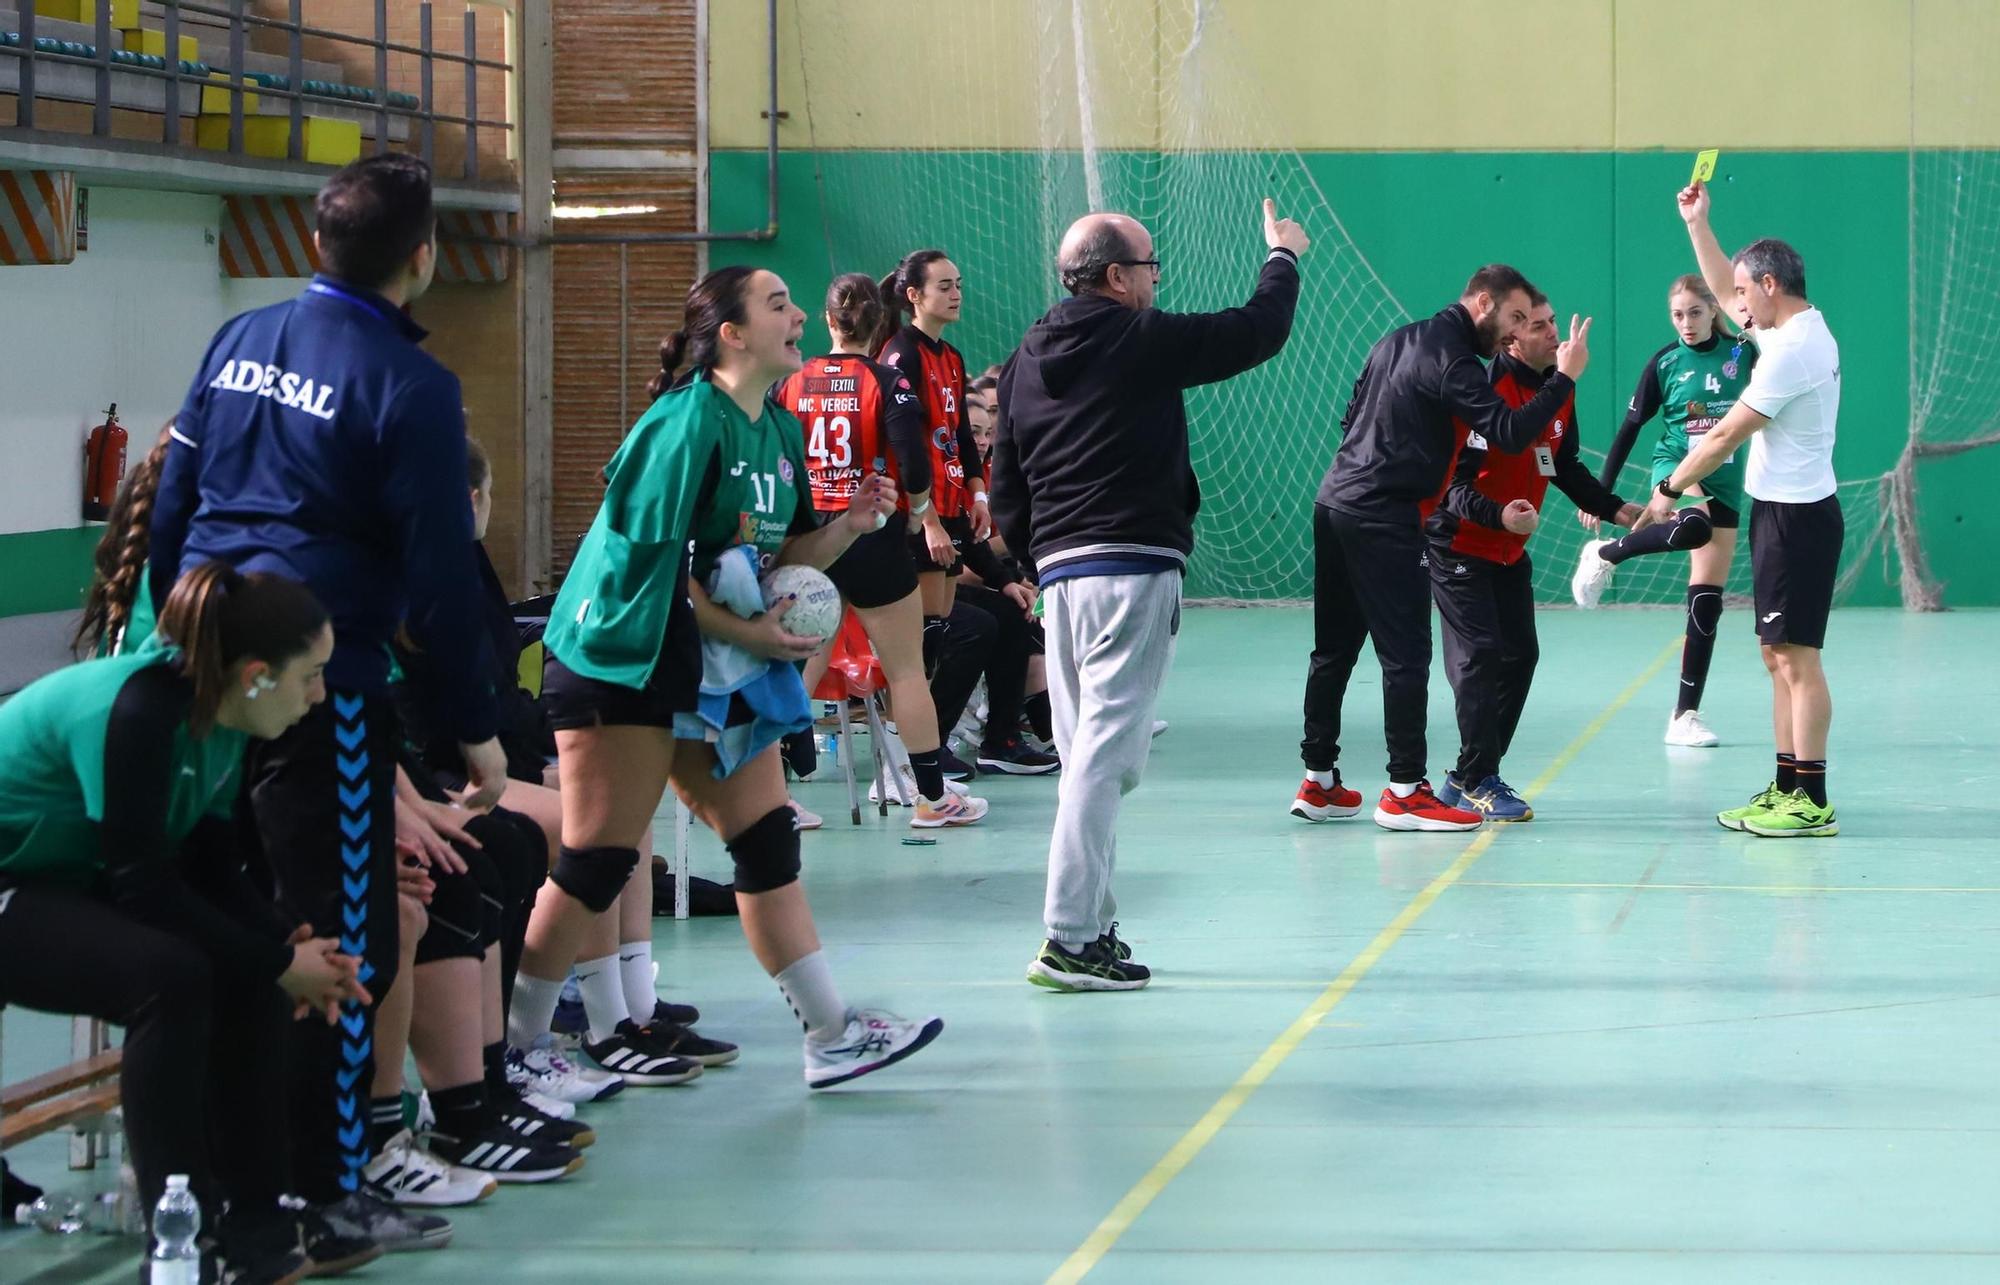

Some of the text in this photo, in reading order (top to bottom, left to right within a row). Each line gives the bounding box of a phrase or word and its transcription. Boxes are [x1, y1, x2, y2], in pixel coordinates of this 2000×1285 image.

[210, 360, 335, 420] ADESAL
[1705, 373, 1721, 394] 4
[798, 397, 860, 412] MC. VERGEL
[808, 415, 852, 468] 43
[1540, 455, 1549, 465] E
[750, 472, 775, 513] 17
